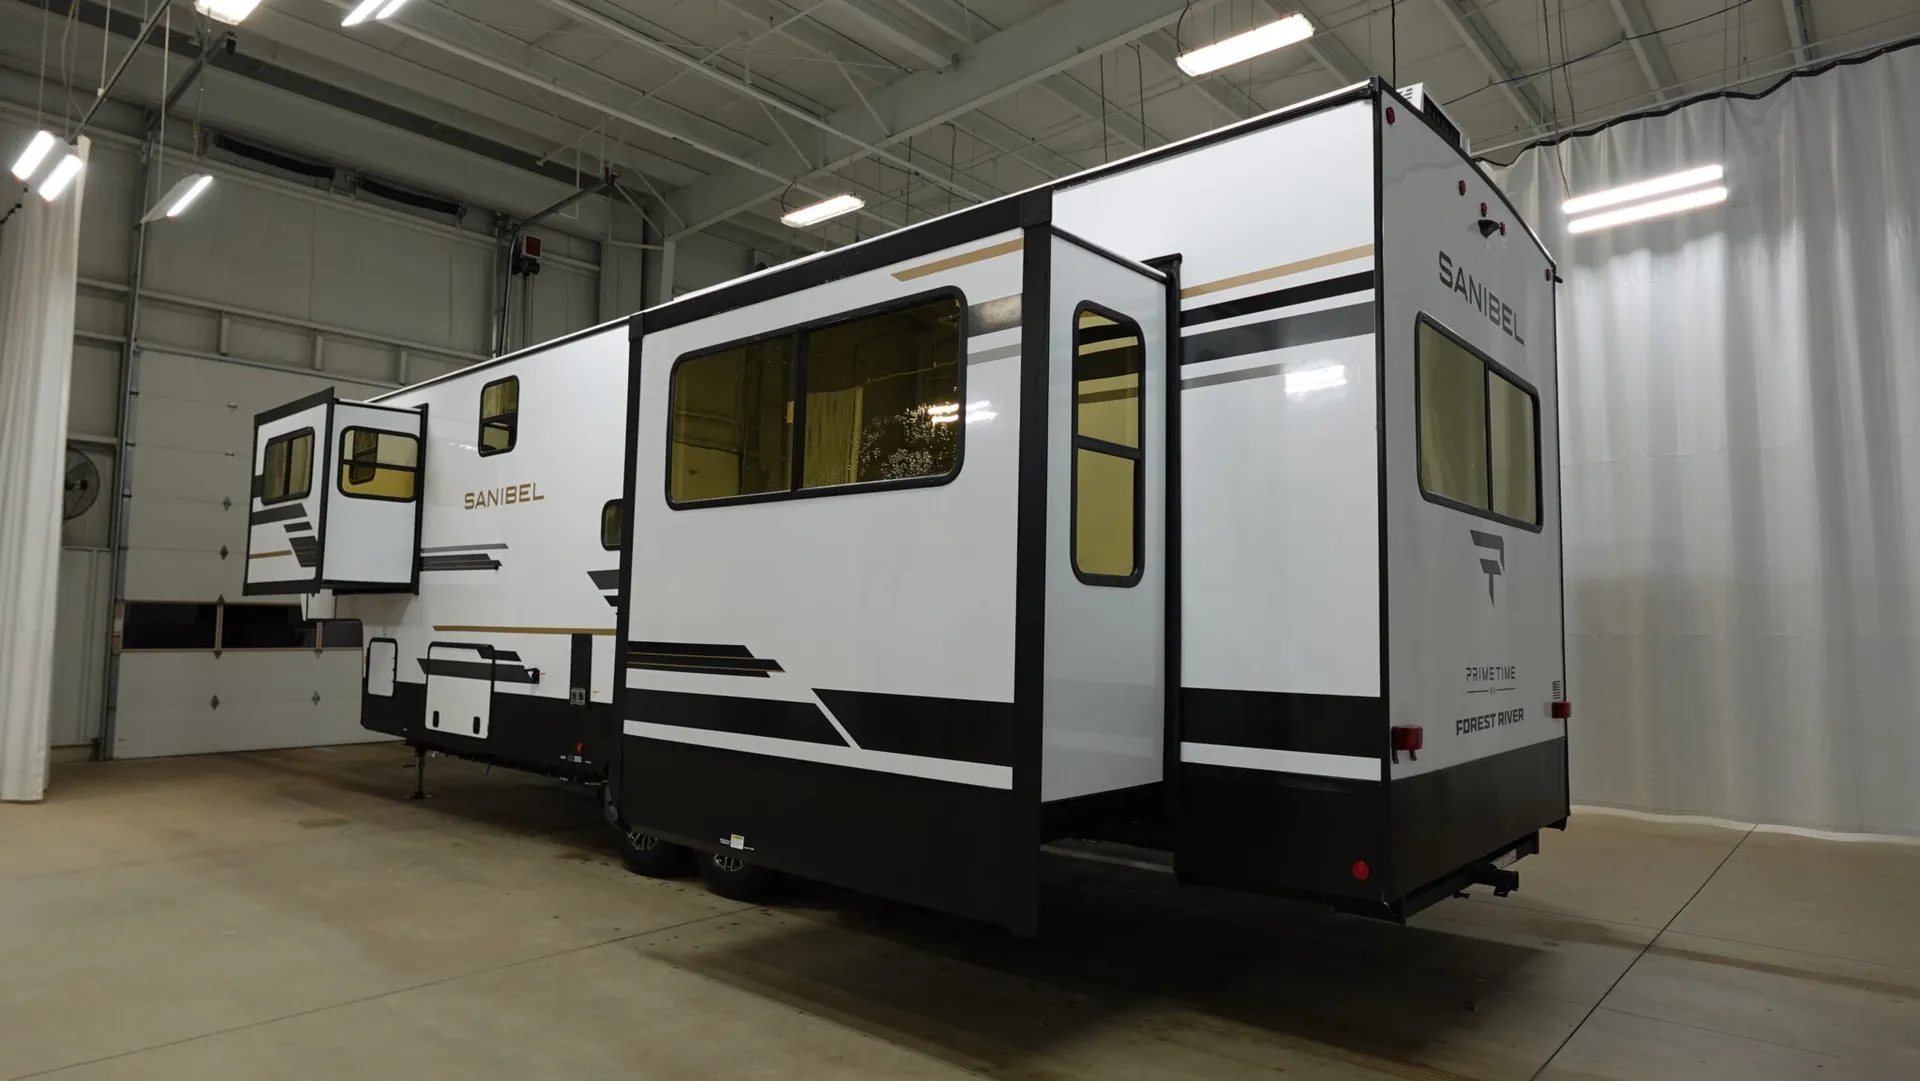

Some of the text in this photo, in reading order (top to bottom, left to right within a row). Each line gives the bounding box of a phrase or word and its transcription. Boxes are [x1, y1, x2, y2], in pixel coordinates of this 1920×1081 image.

[1438, 250, 1525, 346] SANIBEL
[464, 482, 545, 510] SANIBEL
[1456, 707, 1524, 736] FOREST RIVER
